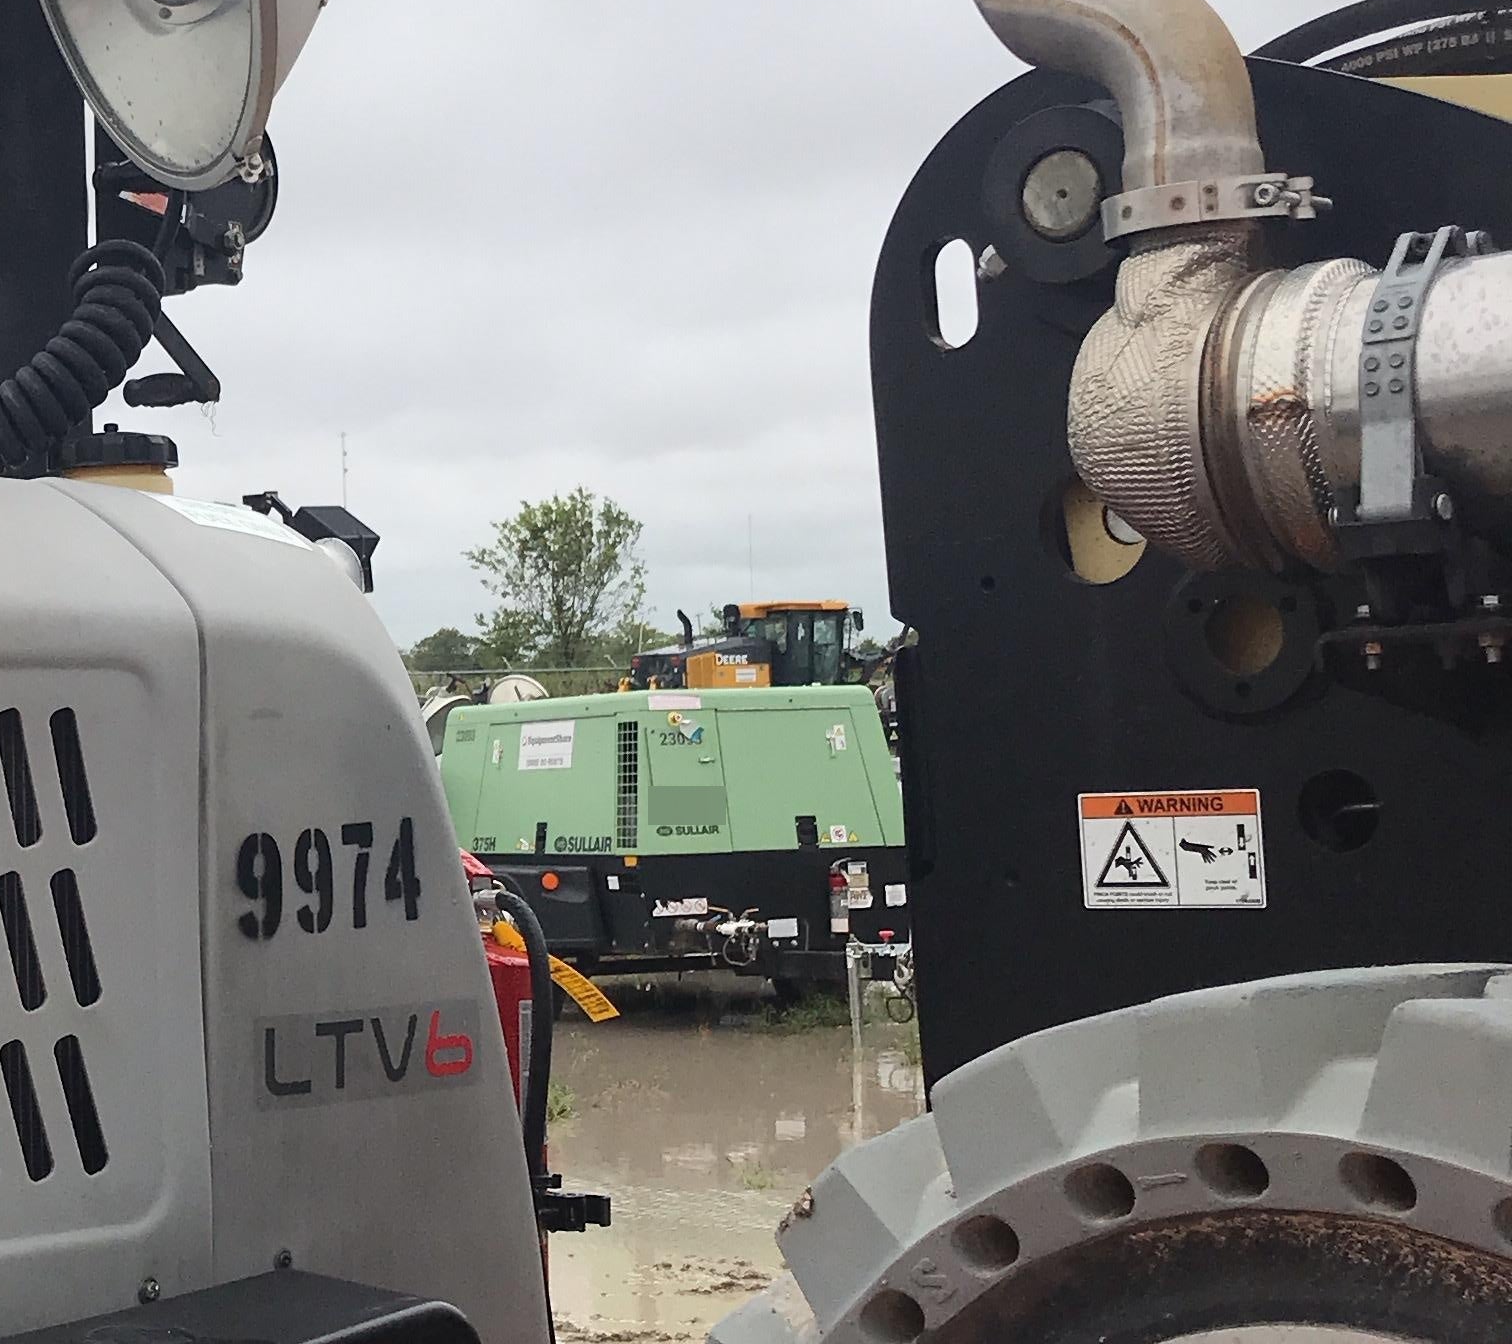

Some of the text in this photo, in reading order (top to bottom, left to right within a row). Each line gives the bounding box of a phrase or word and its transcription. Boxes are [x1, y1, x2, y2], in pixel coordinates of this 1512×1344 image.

[714, 653, 748, 665] DEERE
[1137, 797, 1224, 813] WARNING
[675, 825, 720, 836] SULLAIR
[472, 837, 496, 852] 375H
[567, 836, 613, 853] SULLAIR
[237, 817, 421, 940] 9974
[264, 1009, 473, 1096] LTV6
